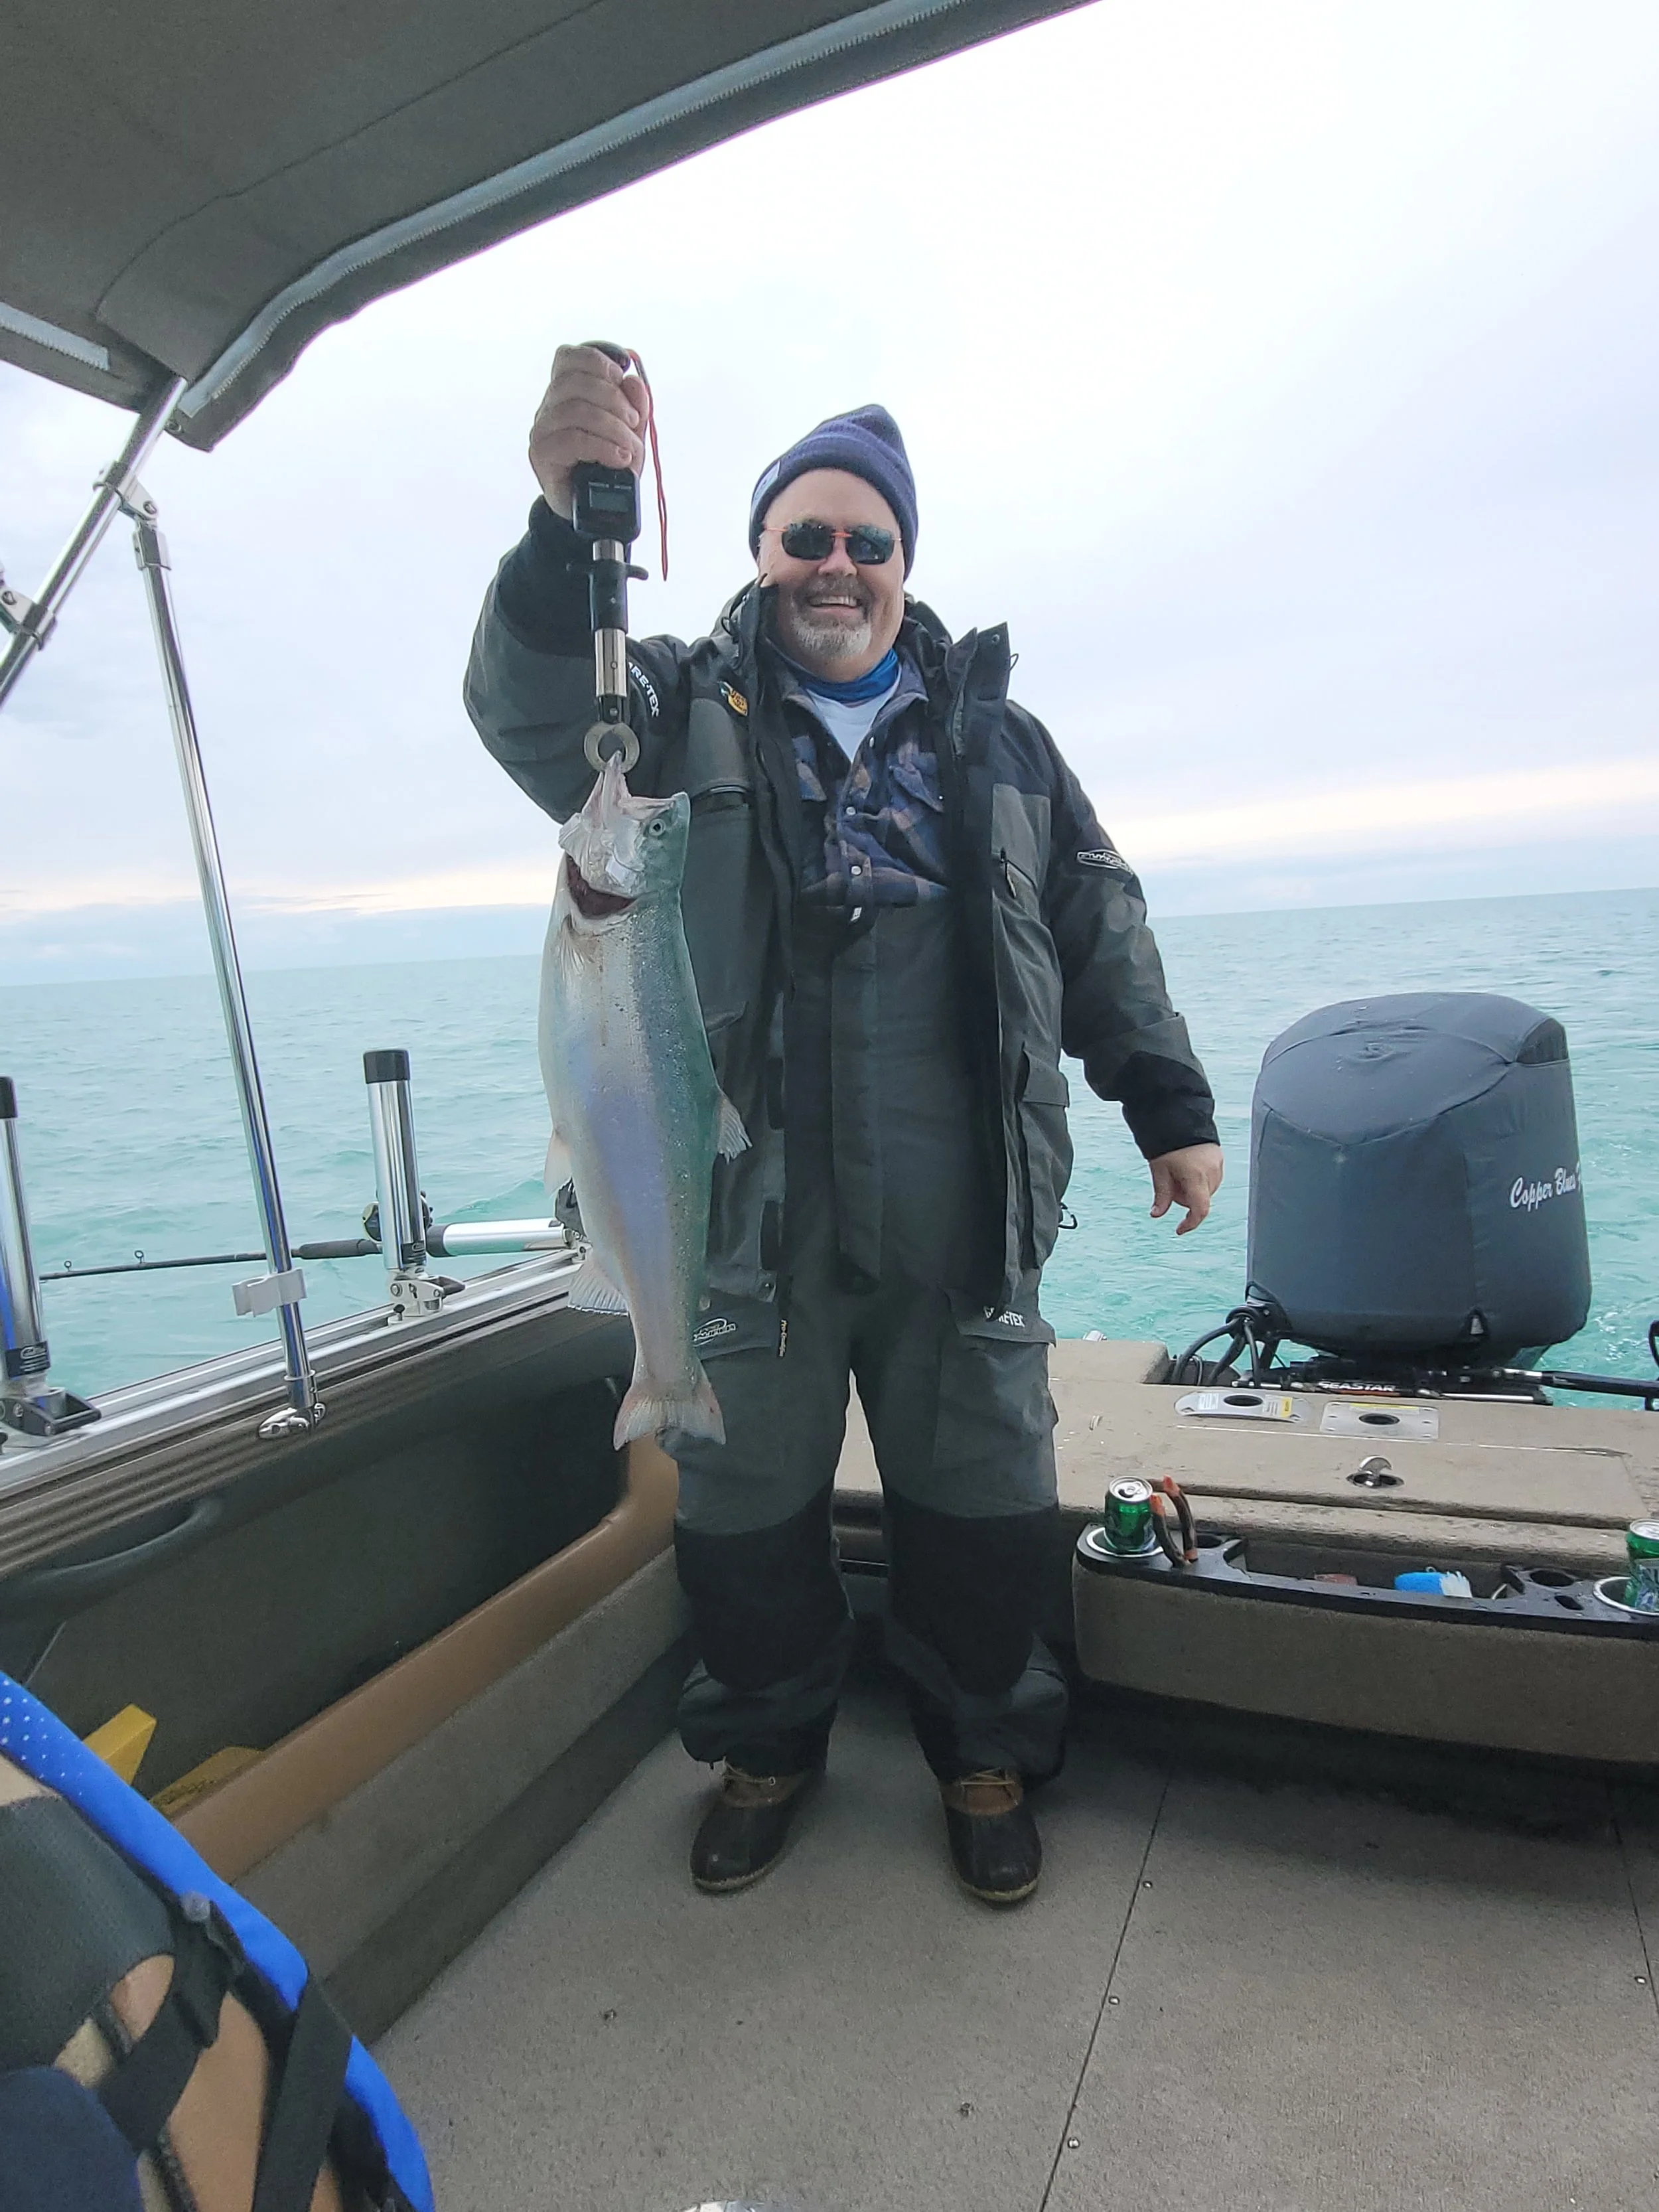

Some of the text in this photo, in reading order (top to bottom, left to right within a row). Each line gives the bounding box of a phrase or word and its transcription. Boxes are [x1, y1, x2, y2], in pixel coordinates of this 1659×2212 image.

[628, 662, 660, 717] RE-TEX
[1510, 1177, 1553, 1212] Copper
[1318, 1380, 1396, 1392] SEASTAR
